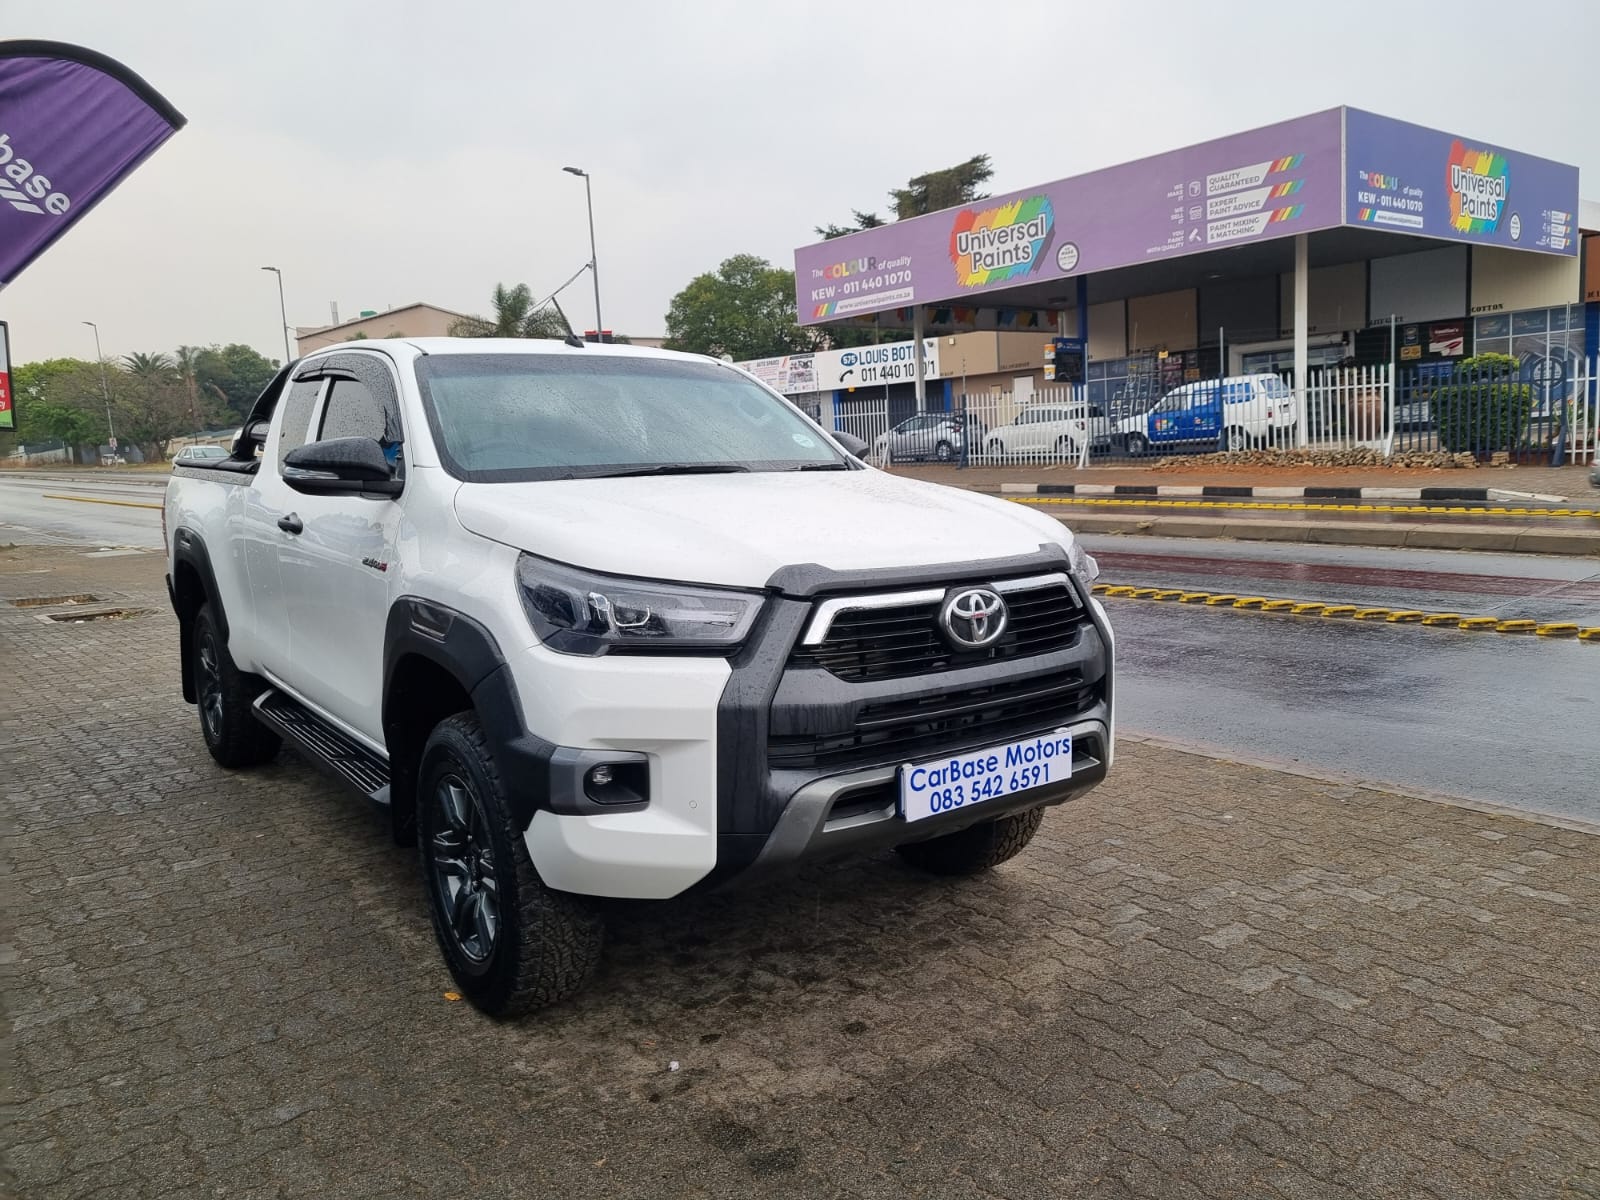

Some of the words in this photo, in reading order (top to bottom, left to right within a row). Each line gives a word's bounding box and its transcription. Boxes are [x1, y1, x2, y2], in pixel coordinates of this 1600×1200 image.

[1209, 172, 1240, 185] QUALITY
[1209, 176, 1260, 192] GUARANTEED
[1452, 166, 1505, 198] Universal
[1210, 196, 1238, 209] EXPERT
[1210, 205, 1232, 217] PAINT
[1233, 199, 1261, 212] ADVICE
[1358, 191, 1376, 205] KEW
[1381, 195, 1392, 208] 011
[1393, 197, 1406, 209] 440
[1407, 199, 1423, 212] 1070
[1461, 192, 1496, 219] Paints
[1210, 221, 1232, 232] PAINT
[1233, 217, 1260, 228] MIXING
[1216, 226, 1255, 239] MATCHING
[957, 215, 1045, 254] Universal
[973, 243, 1031, 272] Paints
[812, 269, 823, 280] The
[824, 256, 877, 280] COLOUR
[878, 260, 886, 270] of
[887, 256, 912, 269] quality
[812, 286, 835, 301] KEW
[844, 281, 859, 294] 011
[862, 277, 881, 291] 440
[884, 270, 912, 286] 1070
[1471, 303, 1504, 313] COTTON
[843, 355, 857, 364] 575
[859, 349, 888, 365] LOUIS
[861, 367, 877, 382] 011
[880, 364, 900, 380] 440
[910, 755, 998, 792] CarBase
[1005, 738, 1070, 768] Motors
[930, 785, 964, 813] 083
[971, 775, 1003, 801] 542
[1010, 763, 1049, 791] 6591
